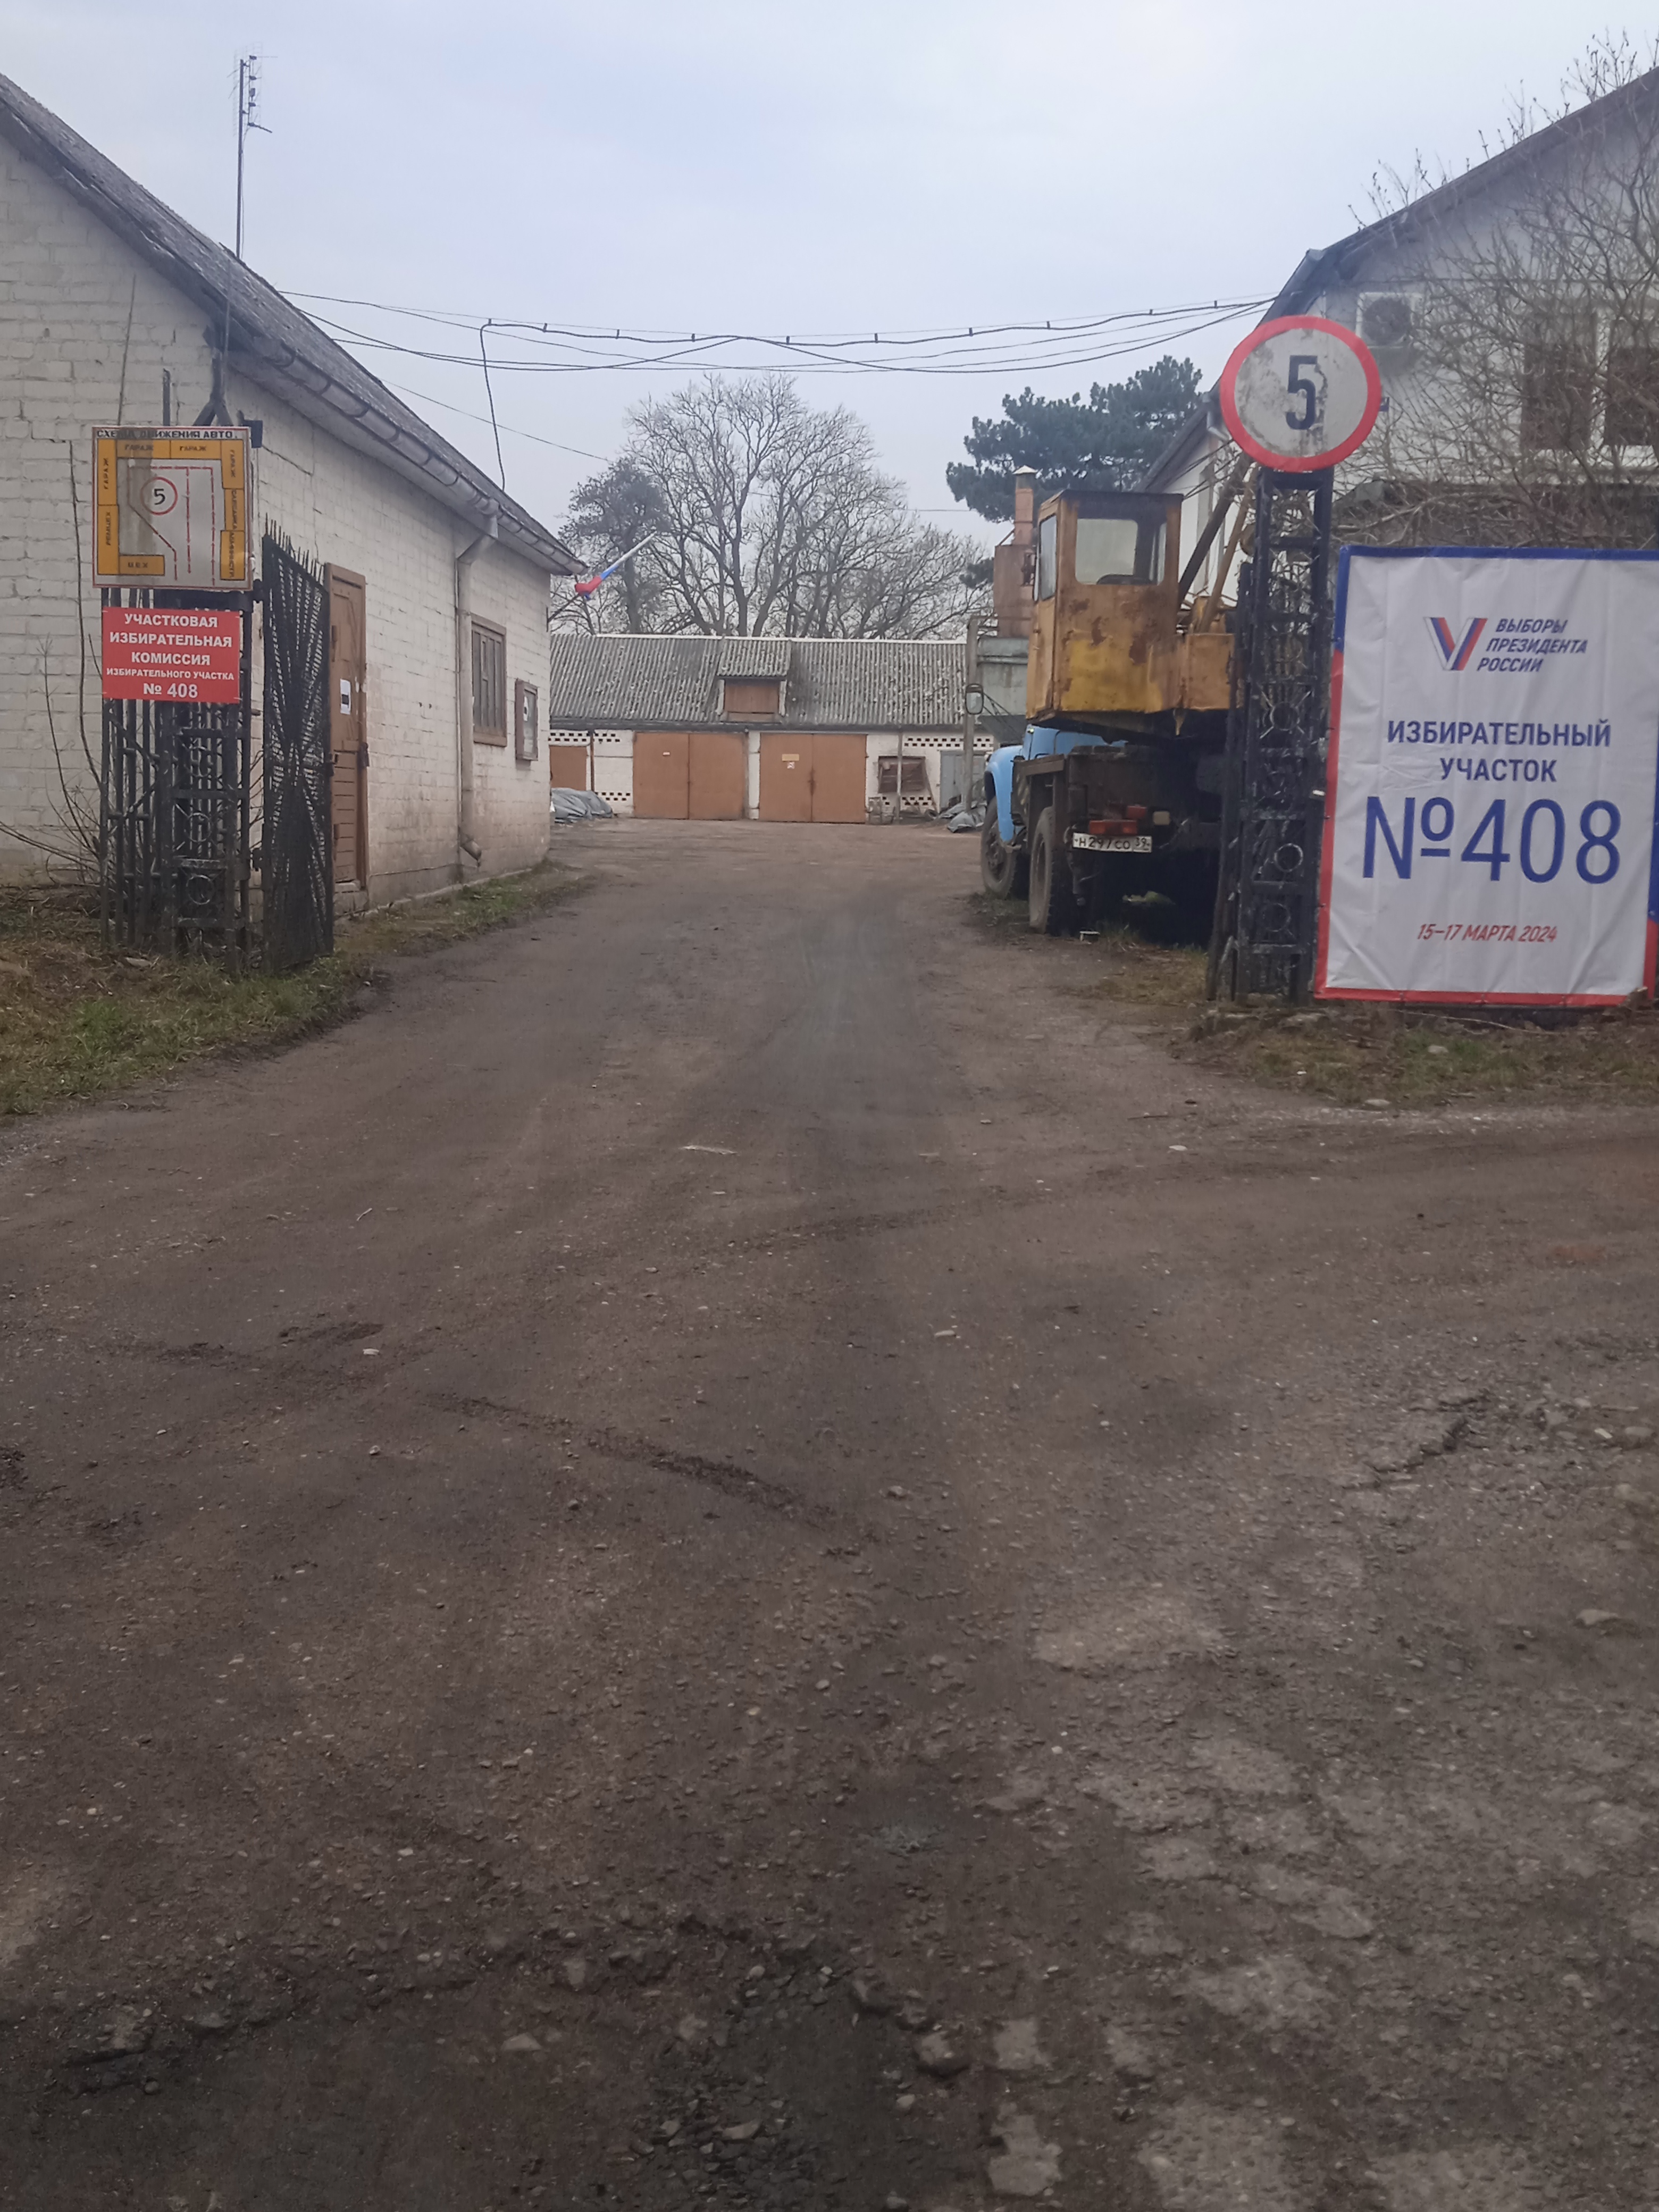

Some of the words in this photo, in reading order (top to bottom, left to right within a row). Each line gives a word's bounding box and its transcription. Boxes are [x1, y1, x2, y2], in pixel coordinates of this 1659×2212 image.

[1286, 355, 1318, 430] 5
[154, 489, 166, 505] 5
[124, 614, 218, 627] УЧАСТКОВАЯ
[1495, 618, 1568, 633] ВЫБОРЫ
[110, 632, 232, 647] ИЗБИРАТЕЛЬНАЯ
[1486, 638, 1588, 654] ПРЕЗИДЕНТА
[131, 652, 211, 665] КОМИССИЯ
[1477, 657, 1544, 672] РОССИИ
[106, 668, 191, 678] ИЗБИРАТЕЛЬНОГО
[193, 672, 234, 680] УЧАСТКА
[143, 683, 162, 695] №
[166, 683, 198, 698] 408
[1387, 718, 1611, 747] ИЗБИРАТЕЛЬНЫЙ
[1439, 758, 1557, 782] УЧАСТОК
[1462, 924, 1518, 942] МАРТА
[1518, 926, 1557, 942] 2024
